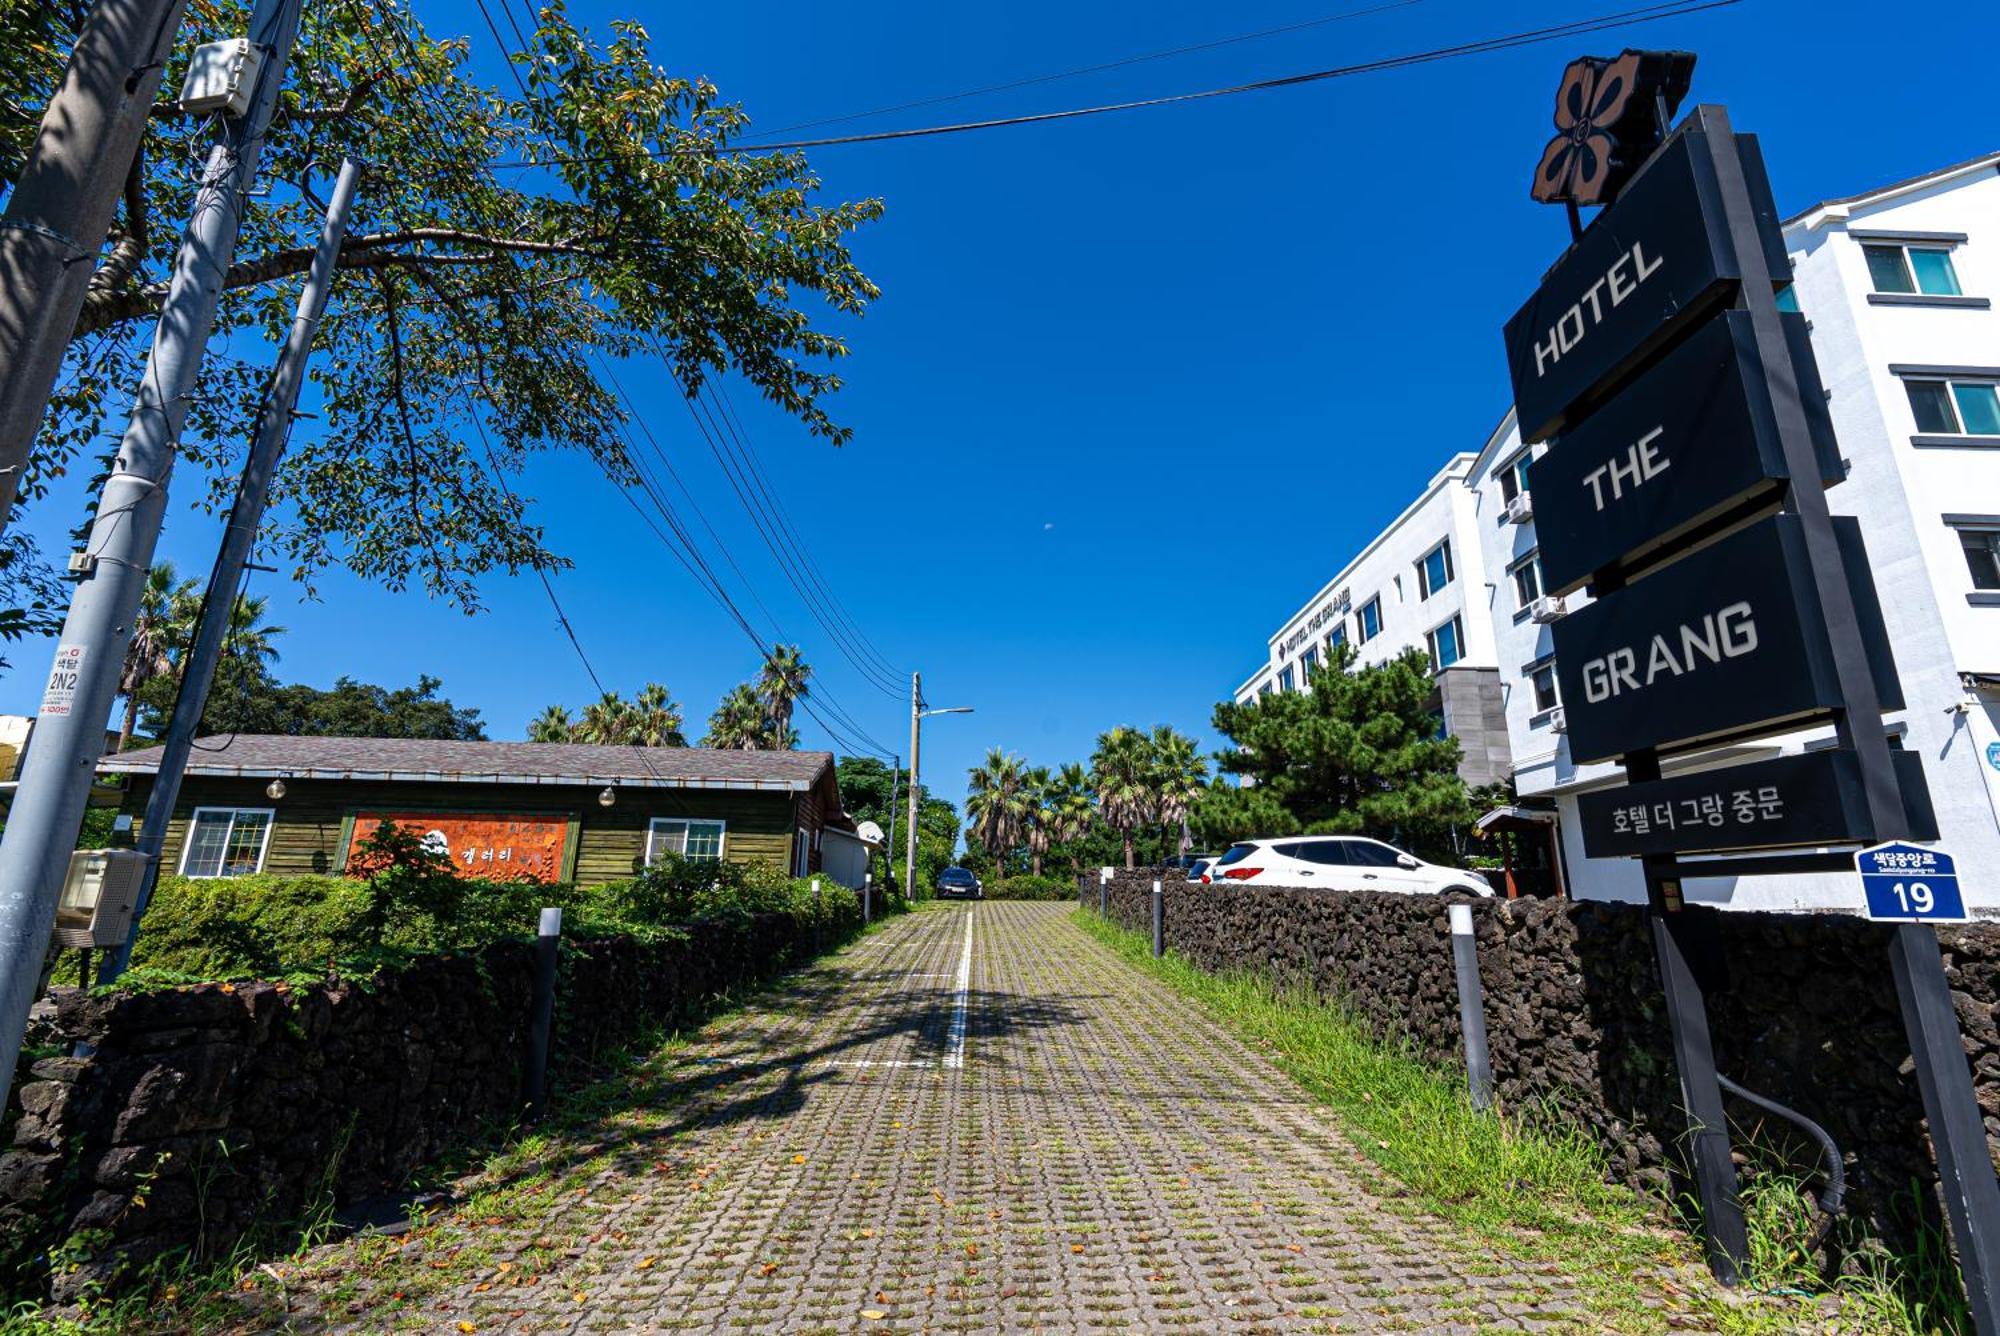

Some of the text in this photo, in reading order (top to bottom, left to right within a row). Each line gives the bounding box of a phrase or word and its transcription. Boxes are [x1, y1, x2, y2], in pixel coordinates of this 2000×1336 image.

[1534, 241, 1664, 378] HOTEL
[1583, 425, 1671, 511] THE
[1582, 601, 1758, 704] GRANG
[50, 673, 77, 690] 2N2
[1613, 786, 1784, 834] 호텔 더 그랑 중문
[1873, 852, 1937, 867] 색달중앙로
[1893, 882, 1934, 913] 19
